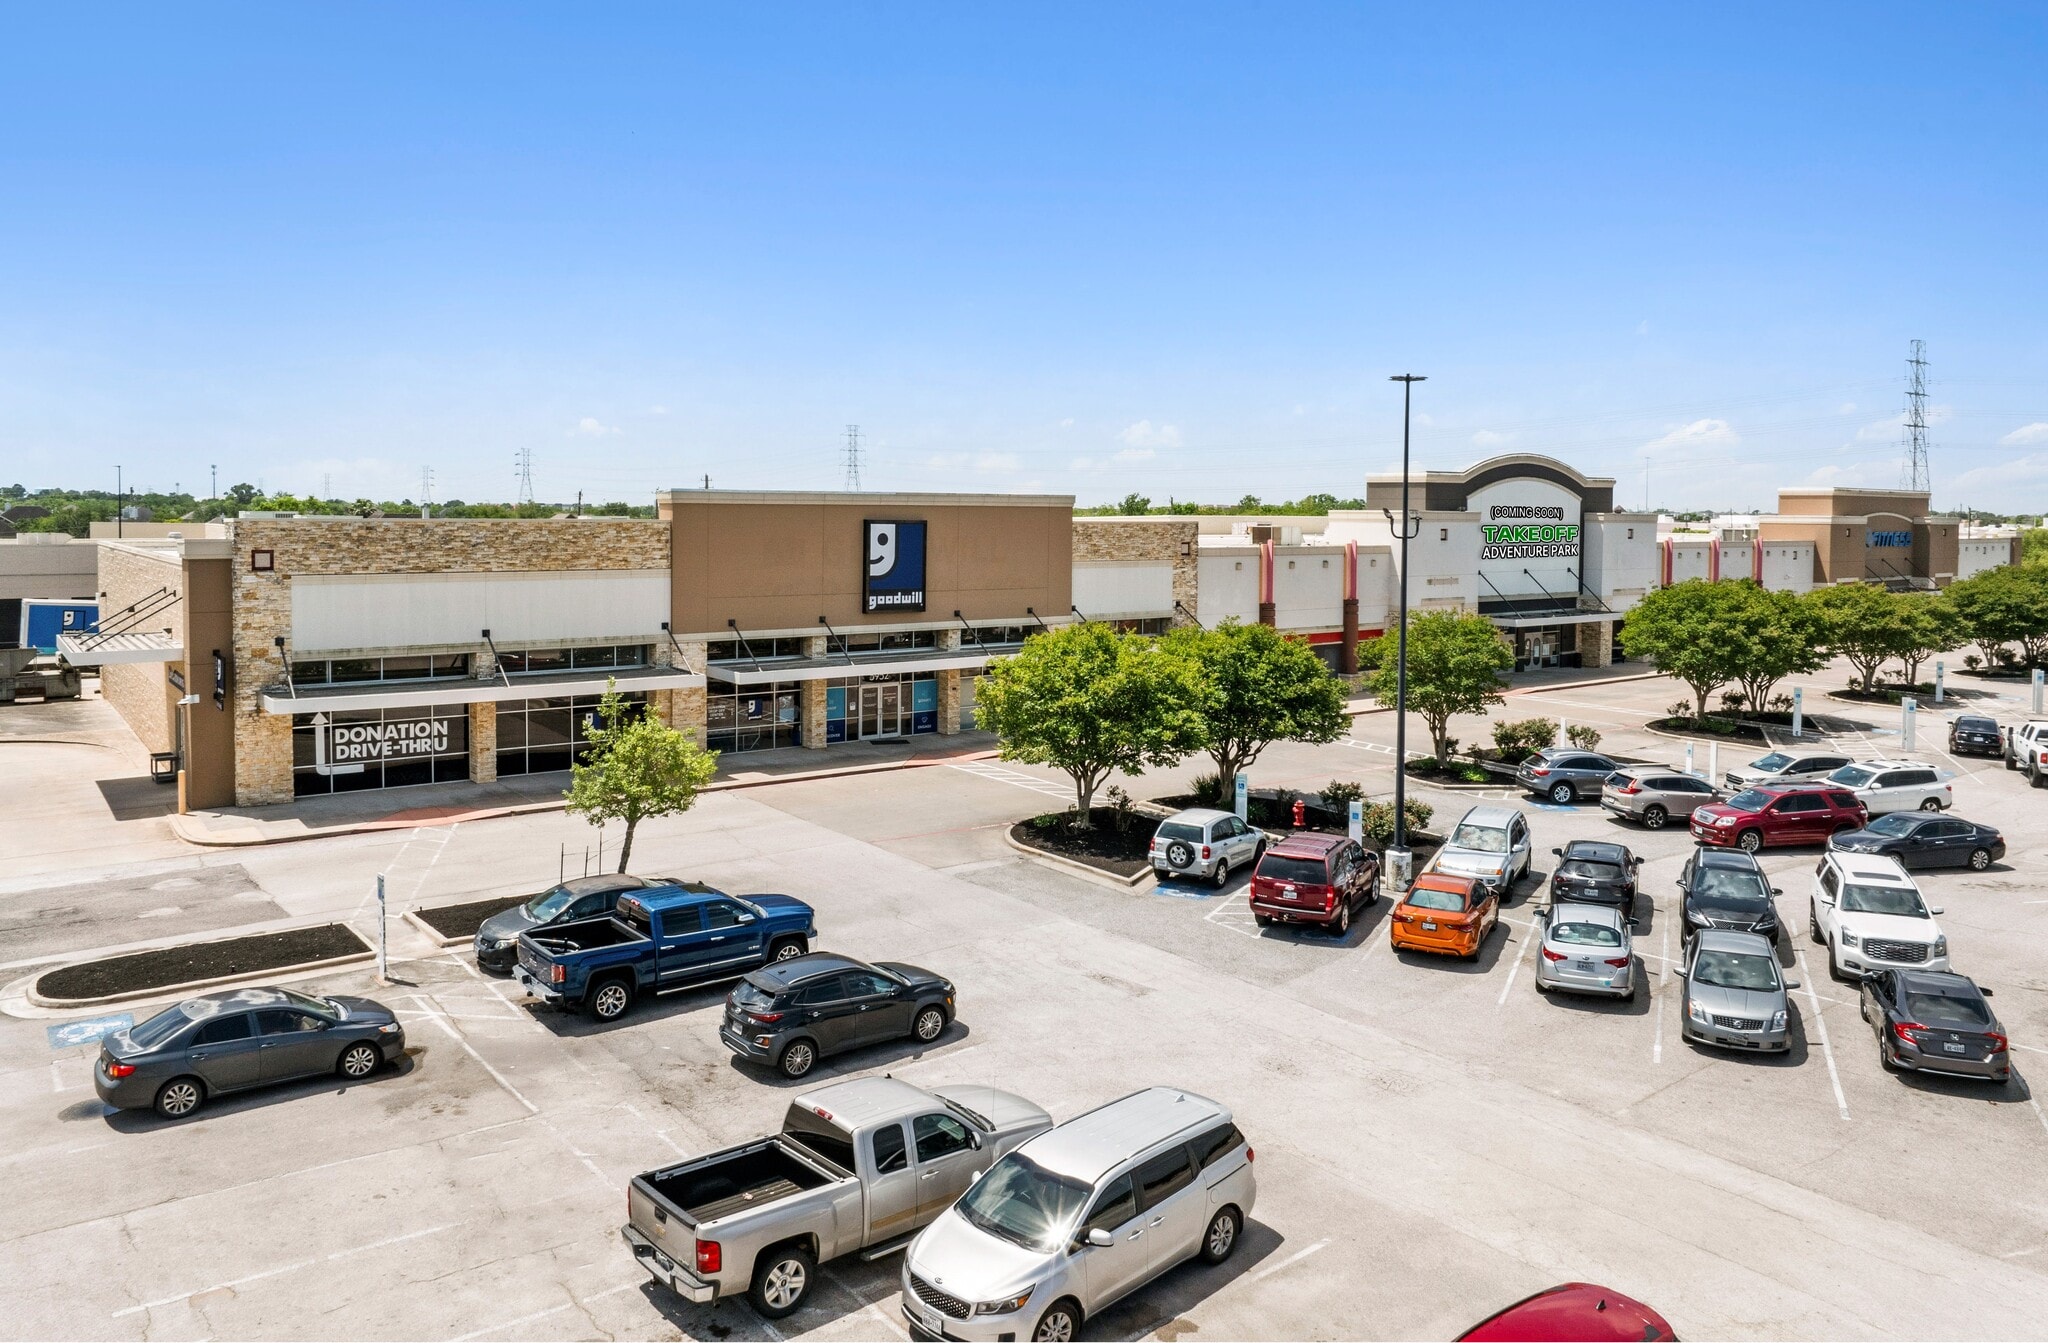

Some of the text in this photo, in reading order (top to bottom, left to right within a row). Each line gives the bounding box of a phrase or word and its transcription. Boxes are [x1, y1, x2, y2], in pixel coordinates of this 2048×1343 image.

[1490, 506, 1564, 520] (COMING SOON)
[1482, 525, 1579, 543] TAKEOFF
[1481, 544, 1578, 559] ADVENTURE PARK
[868, 591, 923, 610] goodwill
[335, 720, 448, 744] DONATION
[335, 736, 448, 760] DRIVE-THRU
